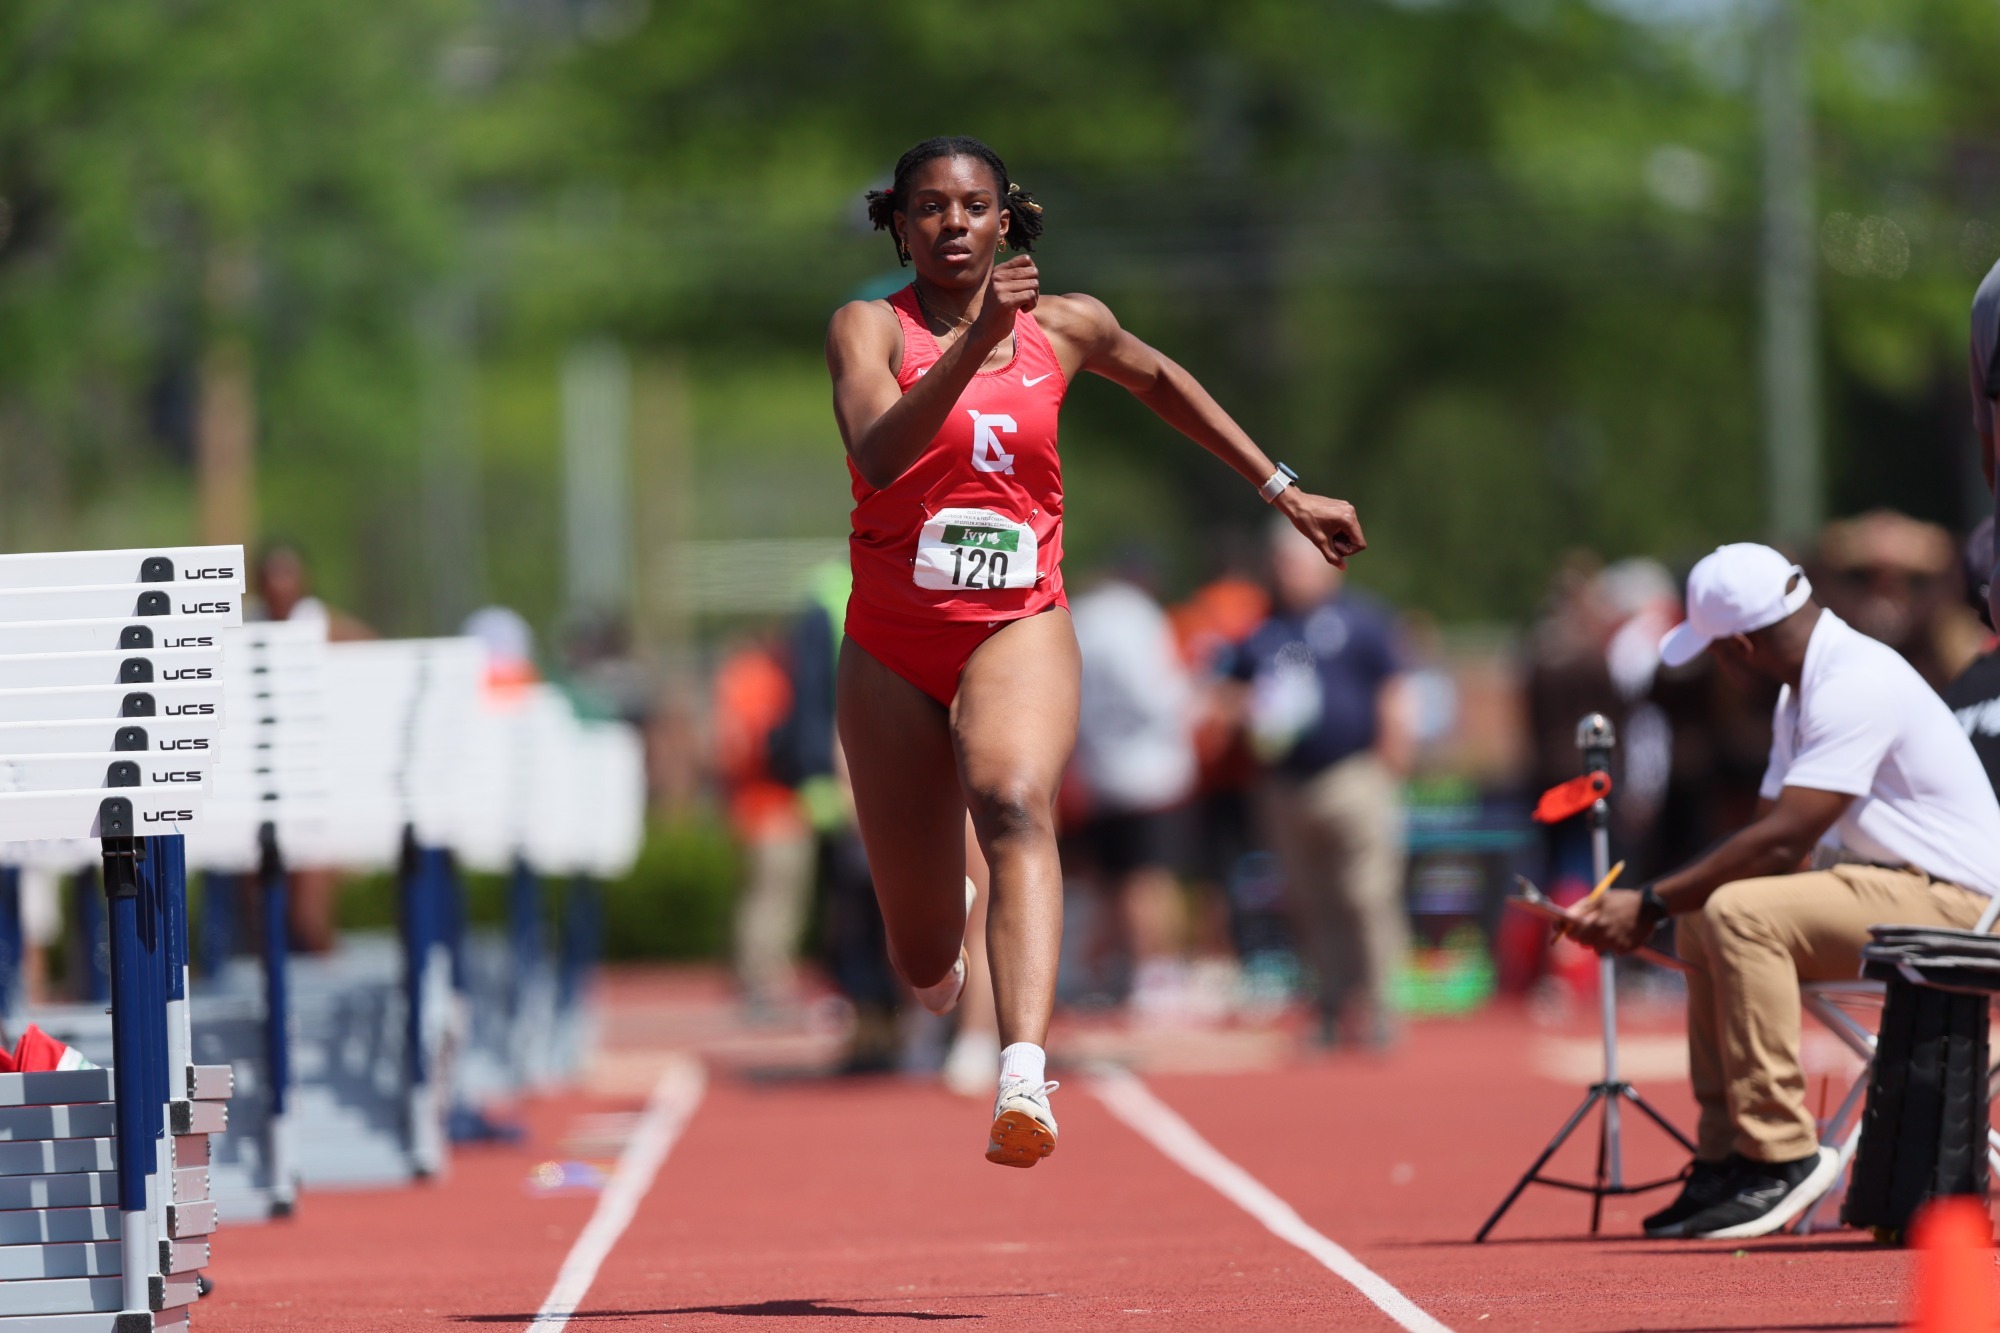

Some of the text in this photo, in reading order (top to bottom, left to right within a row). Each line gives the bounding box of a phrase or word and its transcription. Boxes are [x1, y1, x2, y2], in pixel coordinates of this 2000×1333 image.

[917, 367, 928, 376] Iv
[962, 528, 987, 545] Ivy
[185, 567, 235, 580] UCS
[950, 547, 1008, 589] 120
[181, 601, 232, 614] UCS
[164, 636, 214, 648] UCS
[163, 667, 213, 680] UCS
[165, 703, 215, 716] UCS
[159, 738, 210, 751] UCS
[152, 771, 202, 783] UCS
[143, 809, 194, 822] UCS
